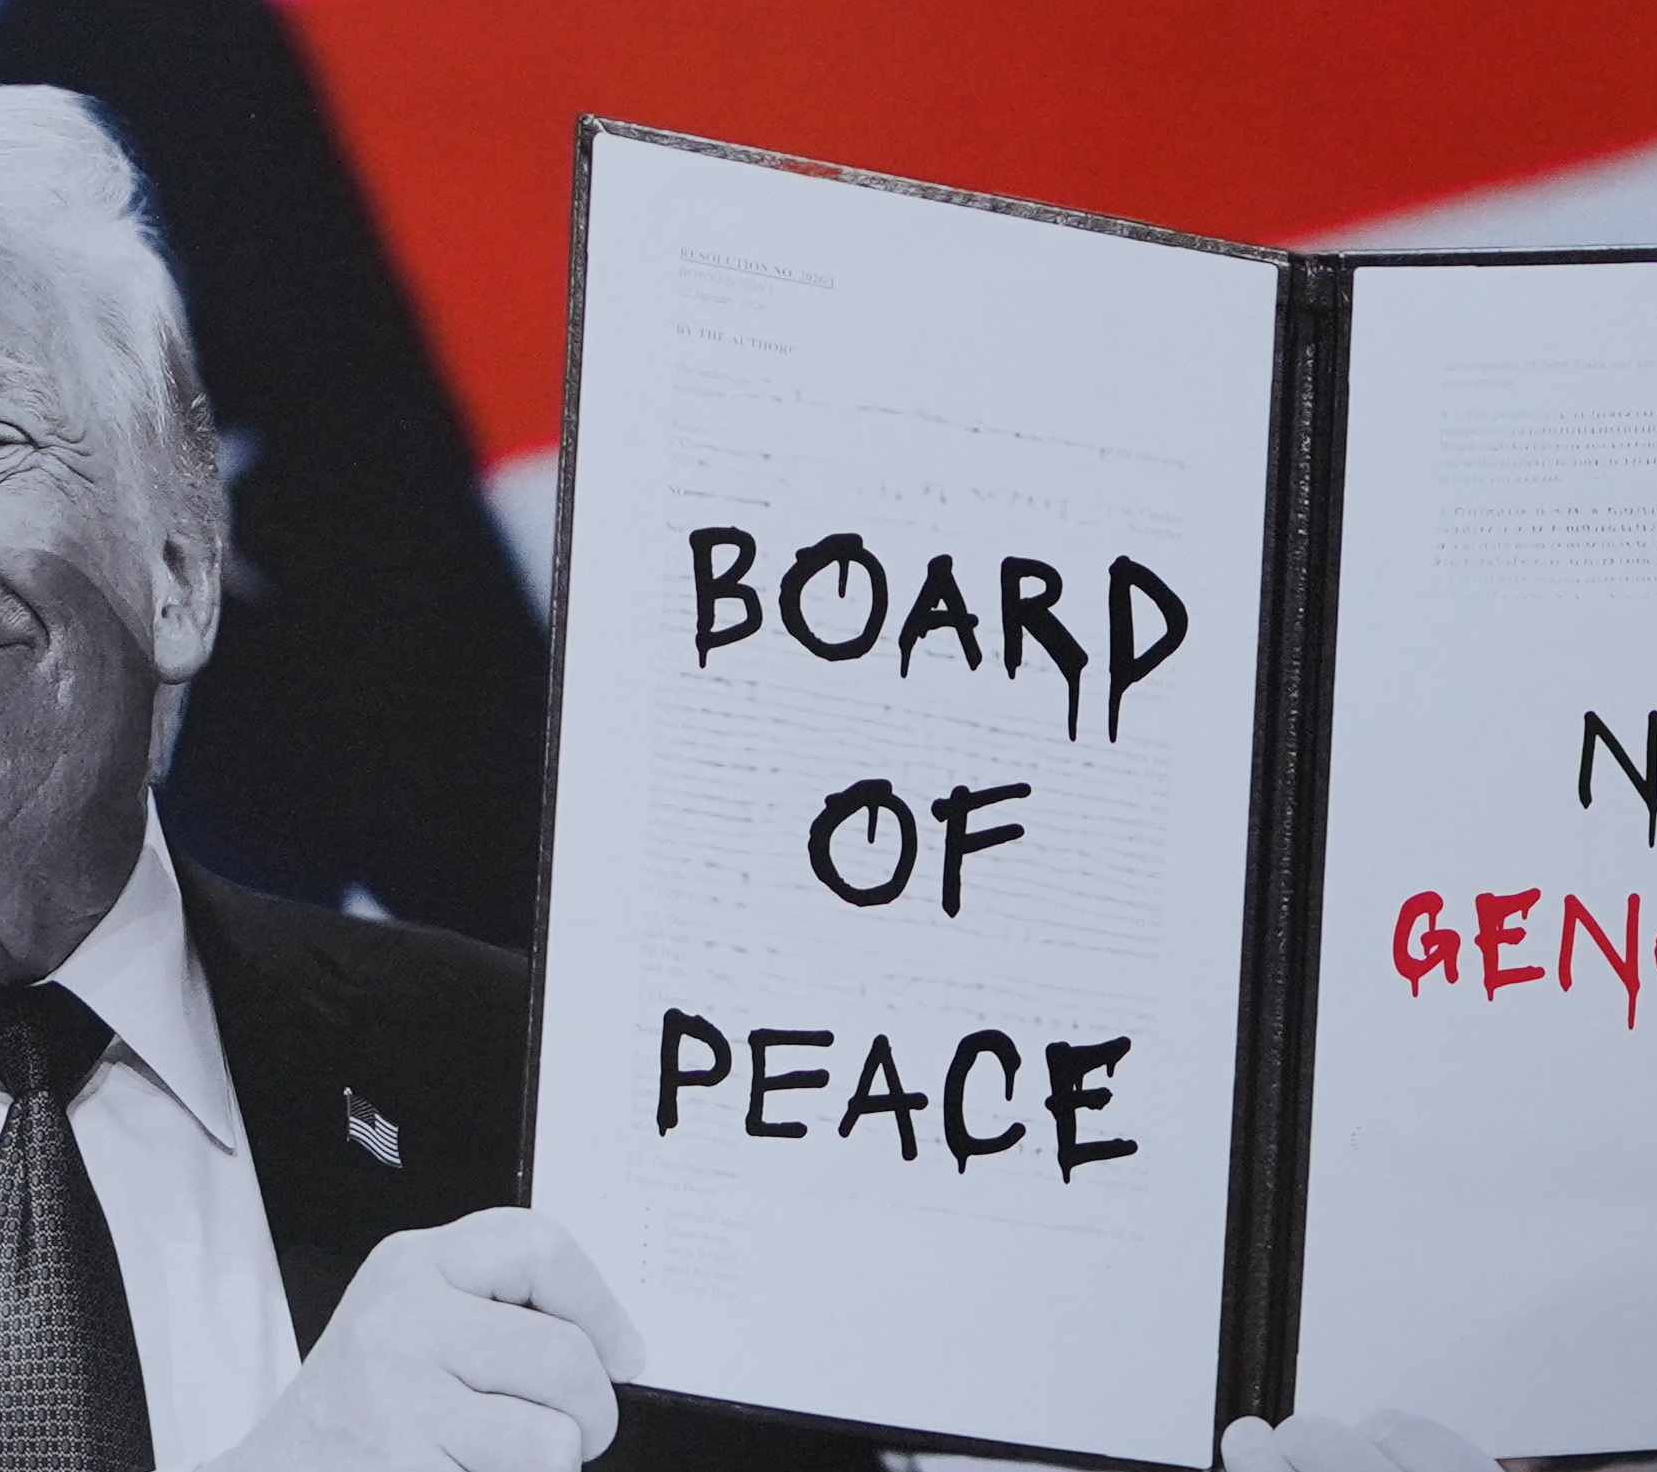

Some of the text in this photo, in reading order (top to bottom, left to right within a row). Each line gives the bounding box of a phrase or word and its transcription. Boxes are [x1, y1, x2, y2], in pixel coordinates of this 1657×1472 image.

[676, 323, 693, 337] BY
[687, 525, 1190, 744] BOARD
[807, 778, 1033, 919] OF
[656, 1007, 1140, 1185] PEACE
